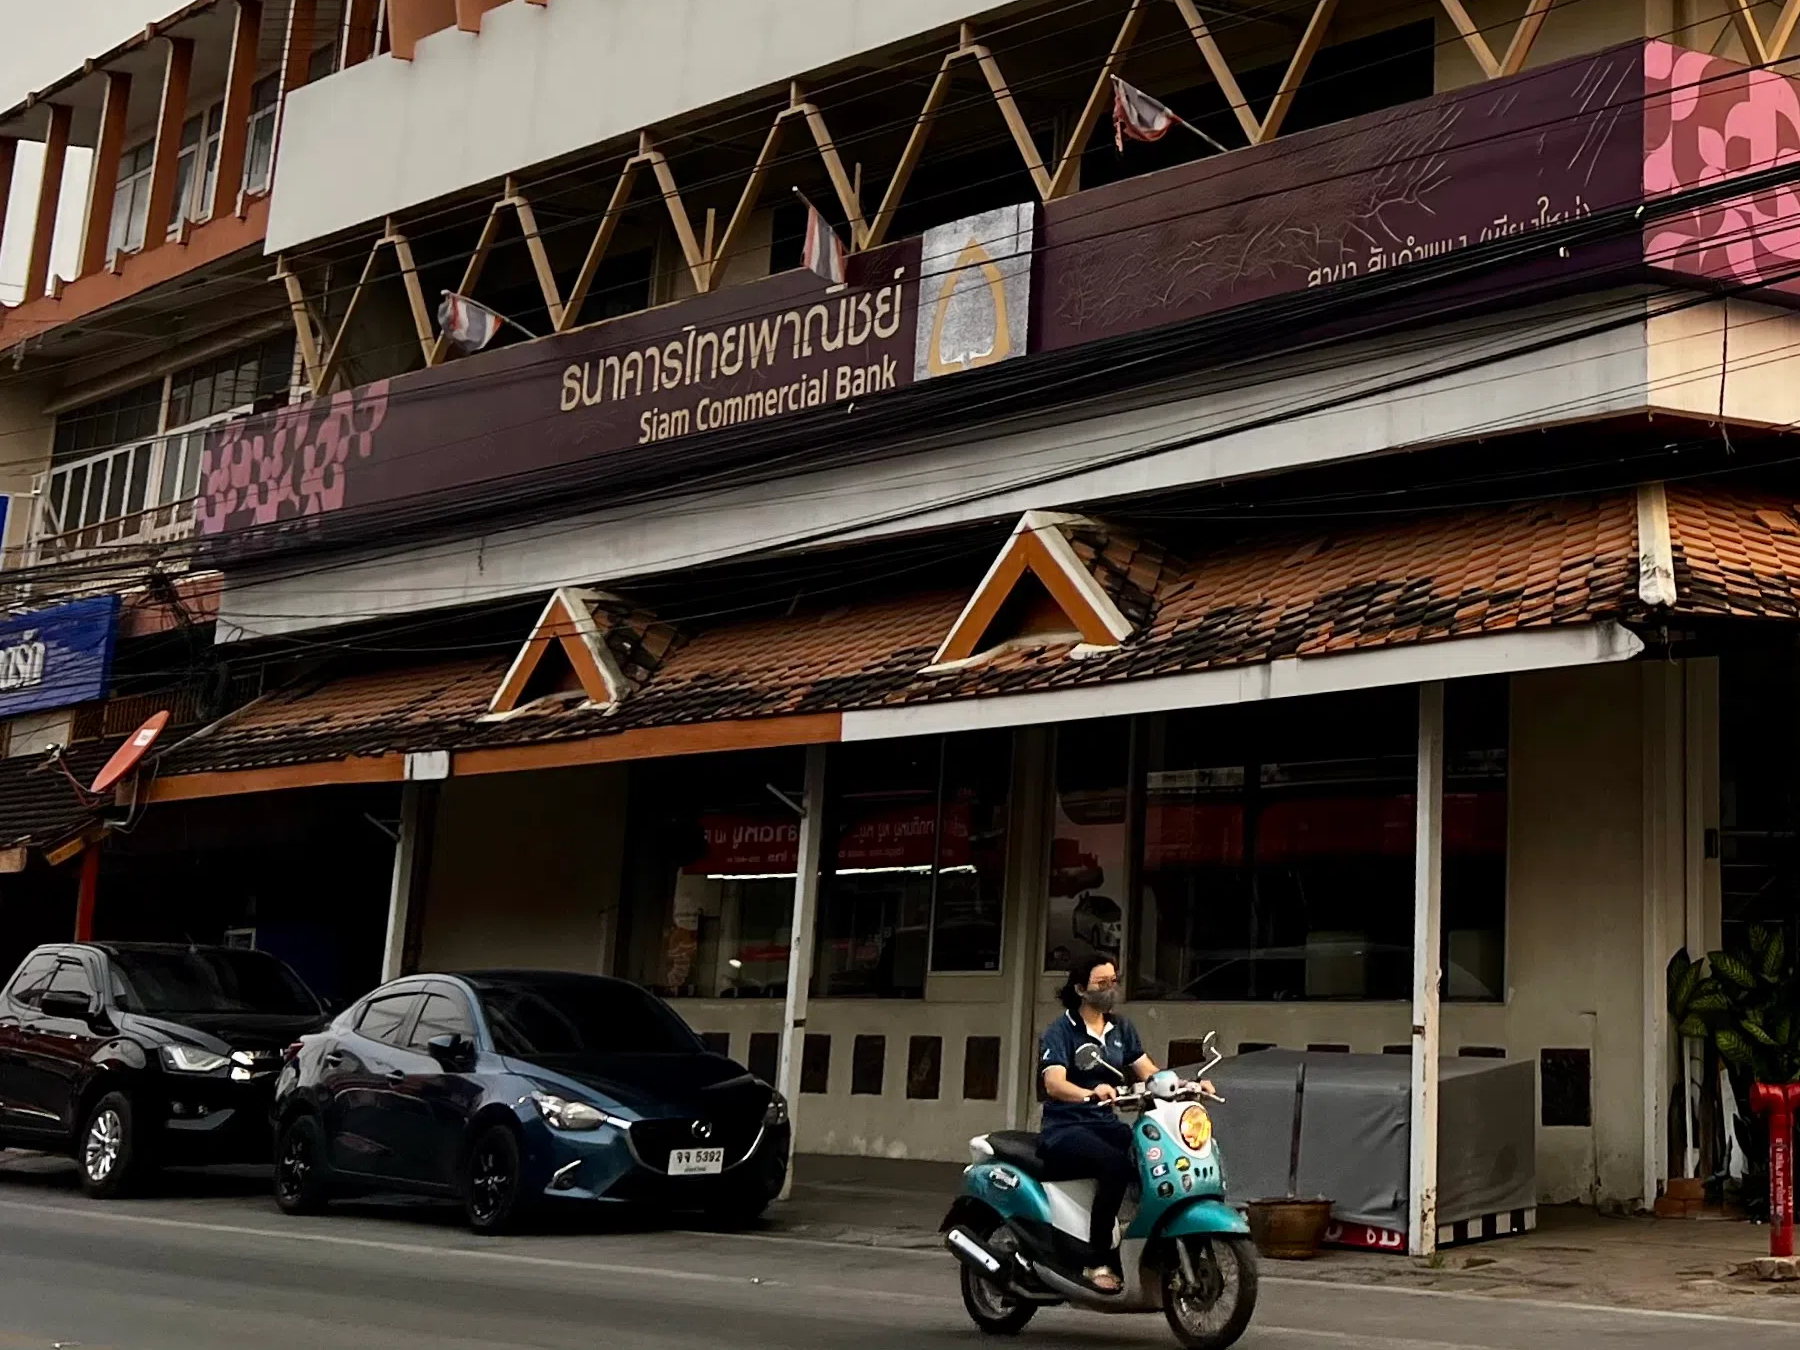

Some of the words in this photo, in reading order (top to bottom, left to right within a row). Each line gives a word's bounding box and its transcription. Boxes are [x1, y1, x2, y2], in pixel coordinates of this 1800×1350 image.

[560, 266, 906, 412] ธนาคารไทยพาณิชย์
[638, 407, 690, 445] Siam
[696, 368, 829, 432] Commercial
[835, 353, 898, 401] Bank
